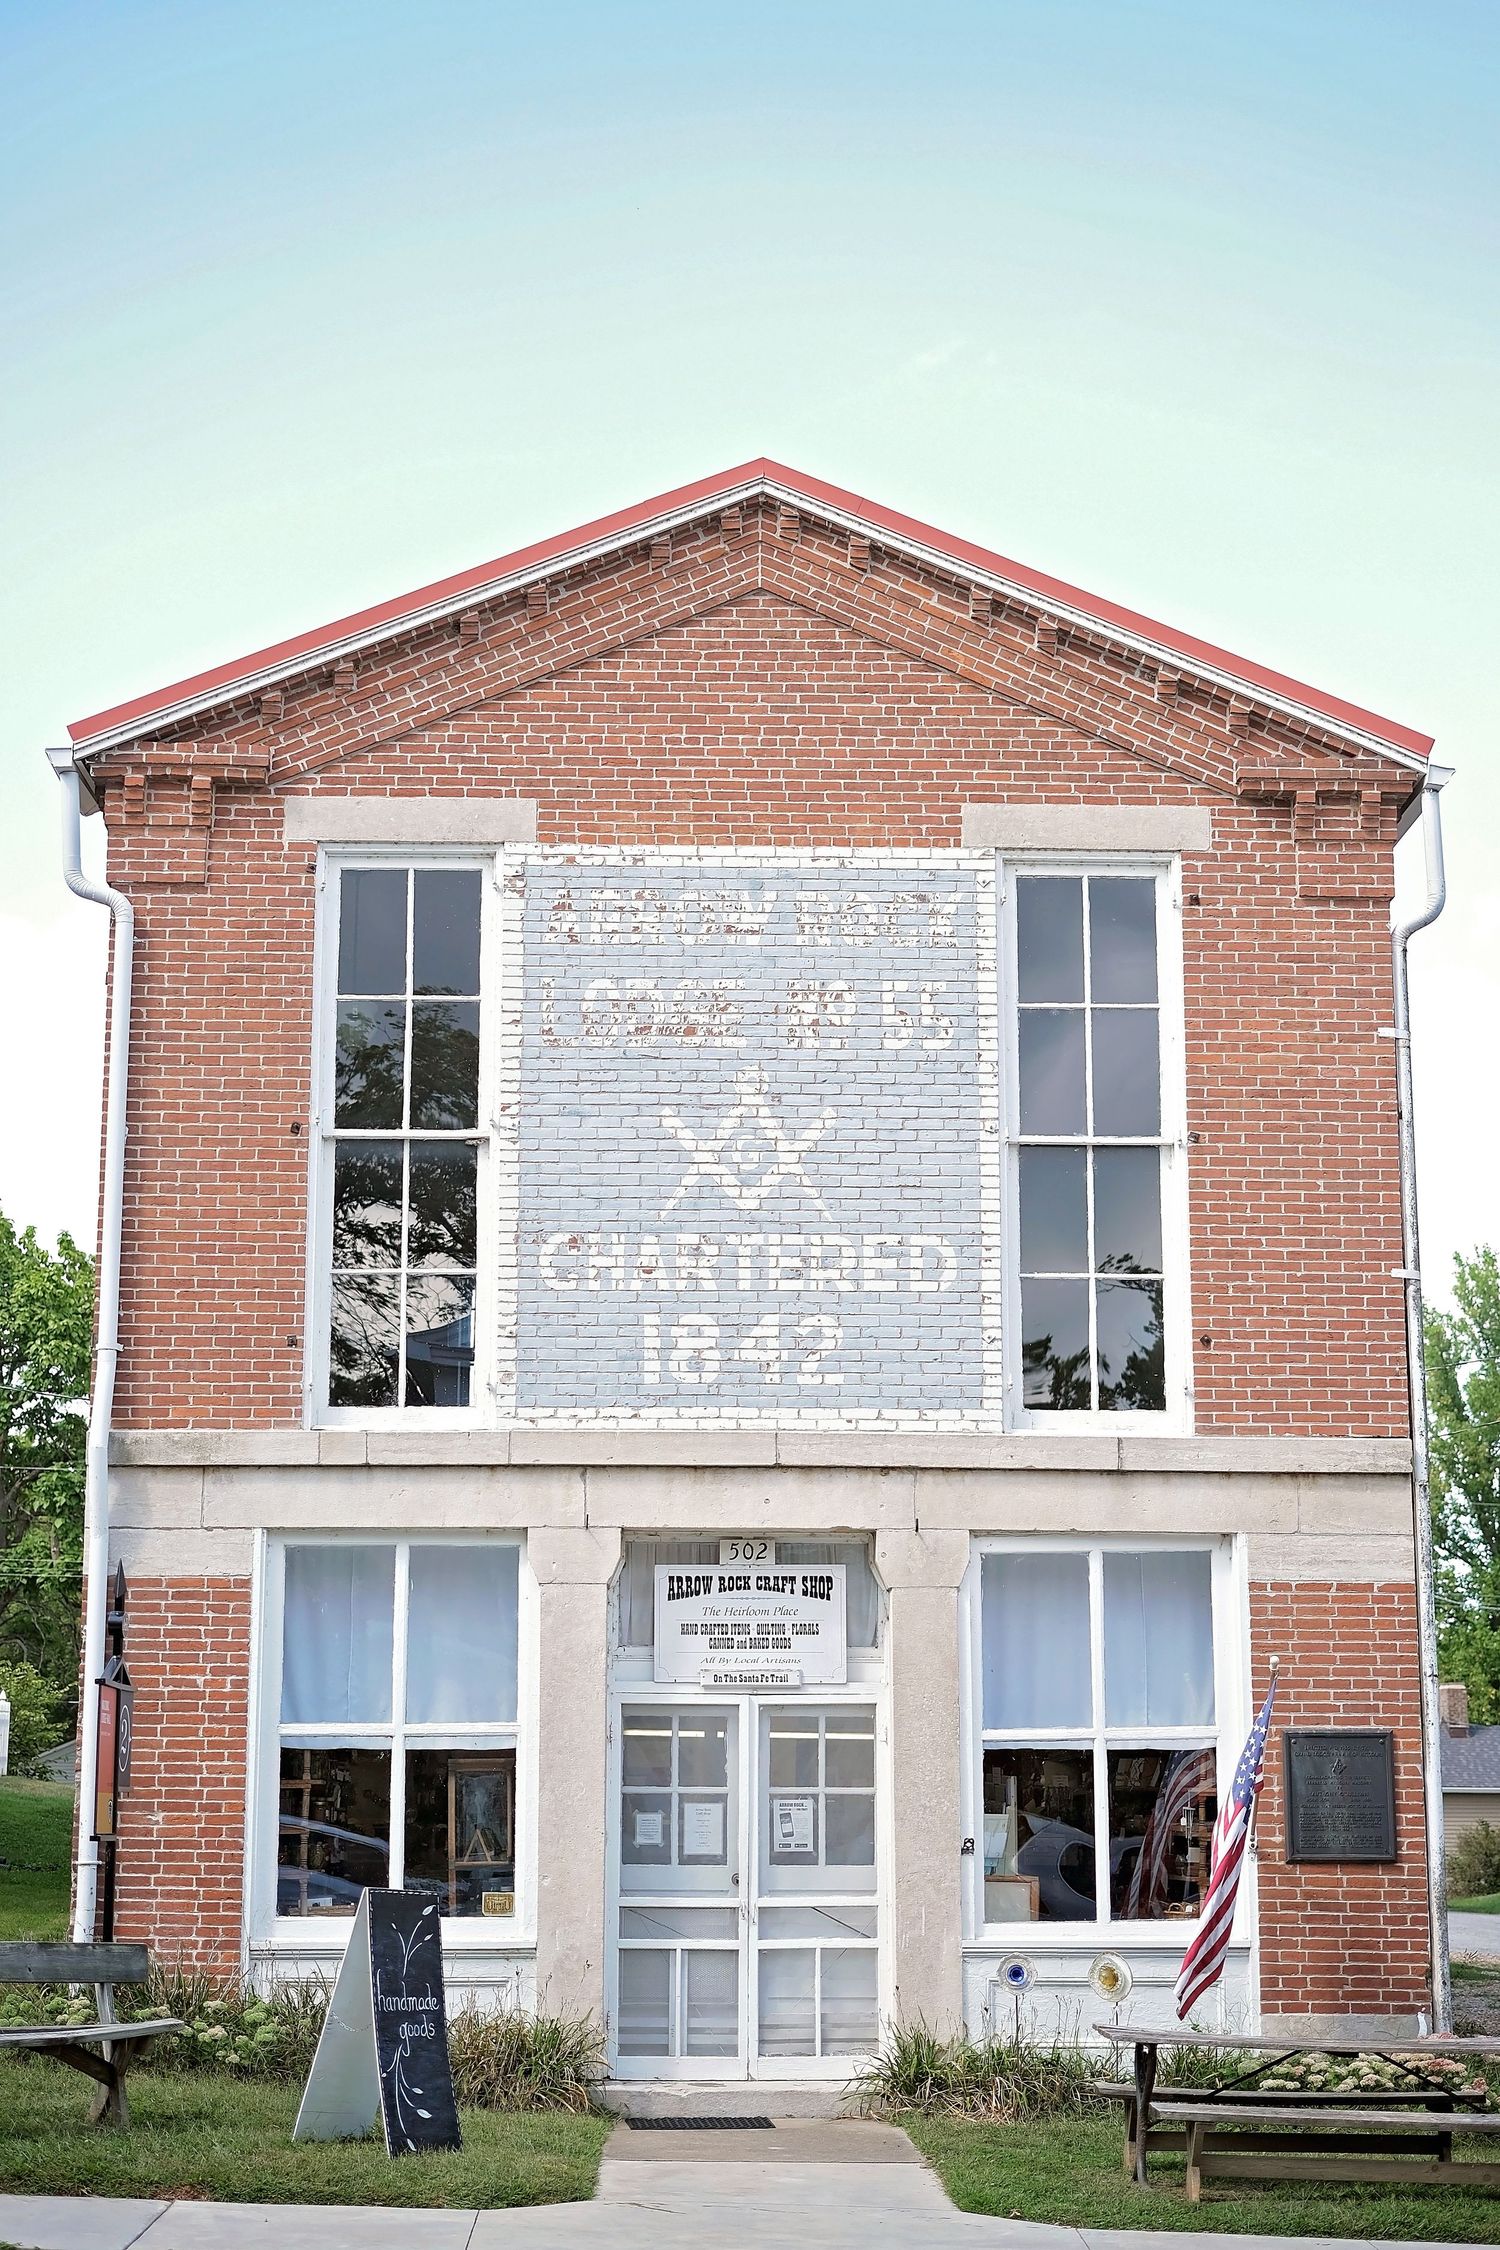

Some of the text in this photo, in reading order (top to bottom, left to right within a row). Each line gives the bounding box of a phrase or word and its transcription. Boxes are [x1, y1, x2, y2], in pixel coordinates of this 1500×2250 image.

[545, 889, 963, 947] ARROW ROCK
[541, 978, 747, 1048] LODGE
[882, 981, 954, 1050] 55
[538, 1232, 958, 1292] CHARTERED
[643, 1314, 845, 1384] 1842
[728, 1542, 768, 1561] 502
[667, 1575, 833, 1601] ARROW ROCK CRAFT SHOP
[702, 1605, 799, 1617] The Heirloom Place
[680, 1623, 820, 1636] HAND CRAFTED ITEMS QUILTING FLORALS
[708, 1637, 792, 1650] CANNED and BAKED GOODS
[700, 1656, 802, 1666] All By Local Artisans
[713, 1674, 789, 1683] On The Santa Fe Trail
[376, 1968, 440, 2013] handmade
[399, 2014, 436, 2058] goods
